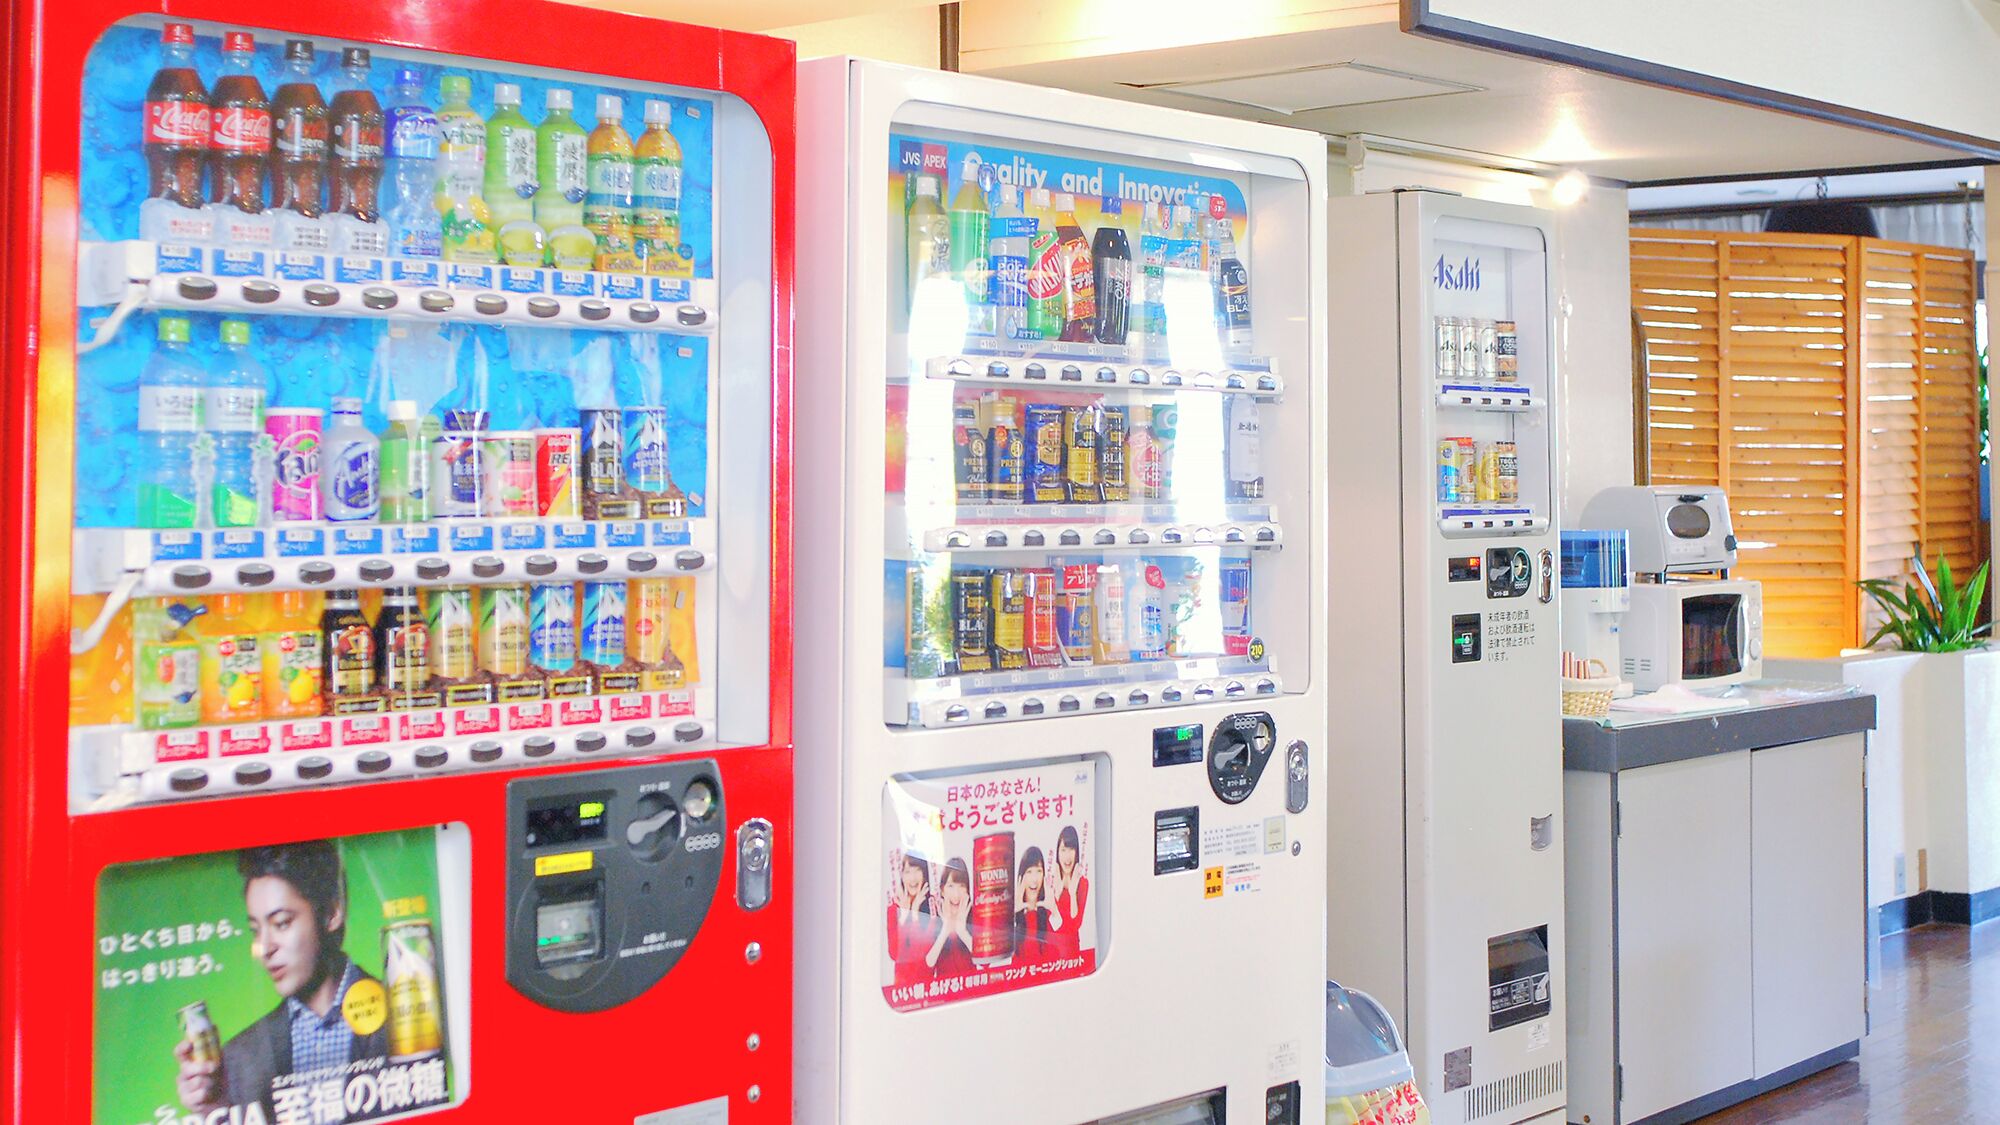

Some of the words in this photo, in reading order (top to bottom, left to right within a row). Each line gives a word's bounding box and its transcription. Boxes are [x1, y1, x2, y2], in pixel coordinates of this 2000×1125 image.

[902, 151, 921, 166] JVS
[924, 154, 946, 169] APEX
[963, 151, 1048, 190] ality
[1061, 167, 1103, 195] and
[1432, 253, 1480, 292] Asahi
[1250, 644, 1263, 656] 210
[947, 777, 1041, 802] 日本のみなさん!
[99, 918, 243, 956] ひとくち目から、
[101, 953, 224, 989] はっきり違う。
[1005, 966, 1027, 980] ワンダ
[1029, 956, 1085, 976] モーニングショット
